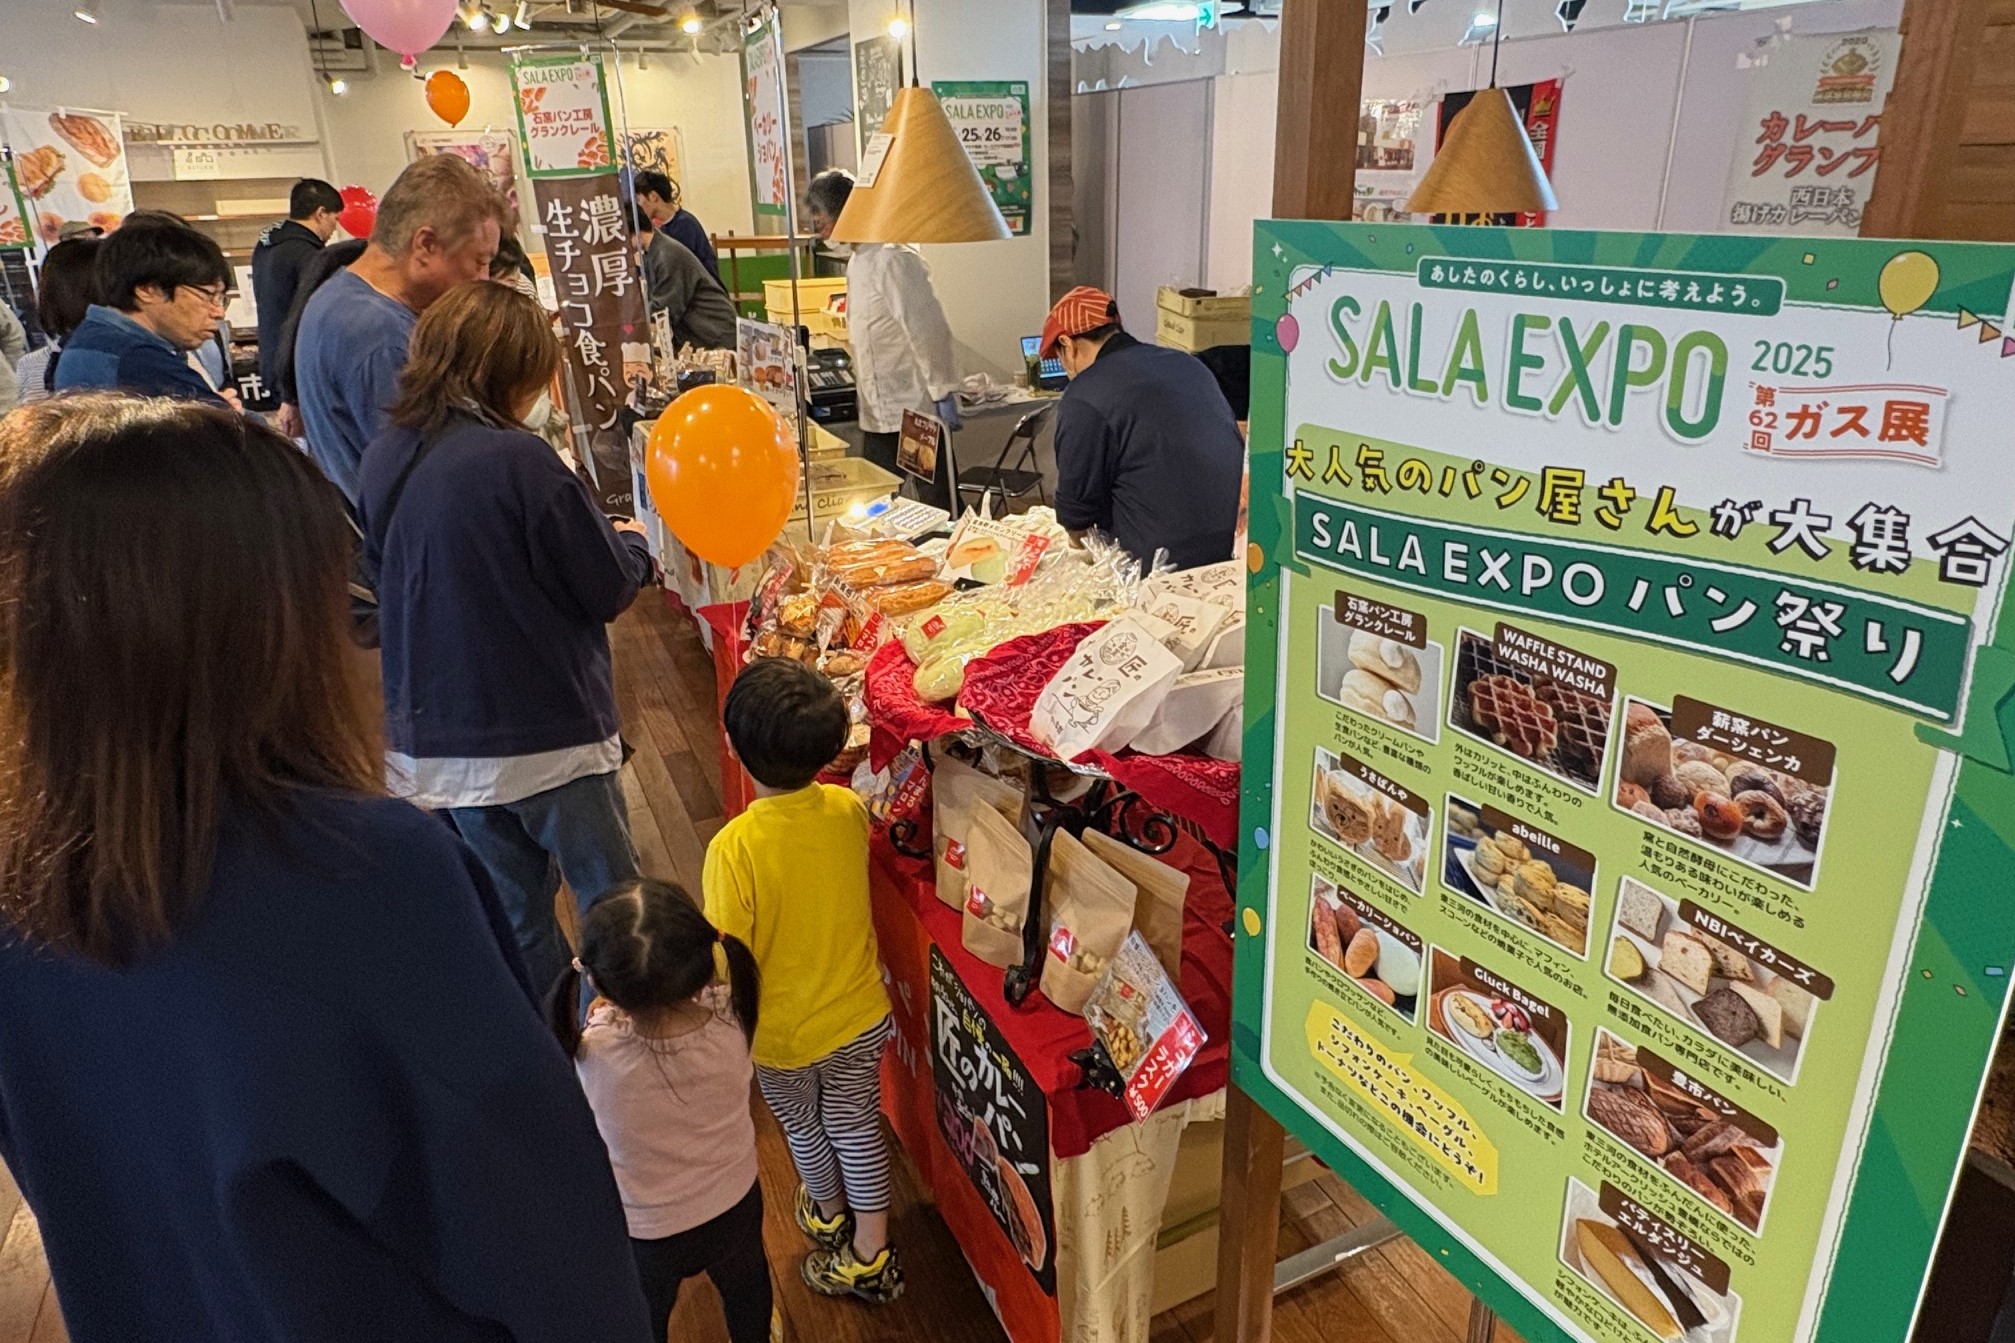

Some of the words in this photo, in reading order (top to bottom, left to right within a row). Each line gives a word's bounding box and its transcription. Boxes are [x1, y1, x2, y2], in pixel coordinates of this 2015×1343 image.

[522, 69, 548, 85] SALA
[550, 67, 573, 82] EXPO
[530, 123, 600, 138] グランクレール
[532, 108, 593, 125] 石窯パン工房
[945, 104, 975, 120] SALA
[976, 103, 1005, 119] EXPO
[1791, 186, 1854, 207] 西日本
[580, 194, 634, 297] 濃厚
[1430, 266, 1761, 307] あしたのくらし、いっしょに考えよう。
[546, 197, 620, 431] 生チョコ食パン
[1328, 296, 1489, 403] SALA
[1511, 311, 1728, 440] EXPO
[1750, 340, 1834, 379] 2025
[1784, 400, 1930, 447] ガス展
[1311, 511, 1428, 577] SALA
[1442, 540, 1606, 607] EXPO
[1626, 573, 1924, 685] パン祭り
[1347, 596, 1413, 628] 石窯パン工房
[1344, 612, 1416, 642] グランクレール
[1498, 643, 1548, 675] WASHA
[1551, 665, 1605, 698] WASHA
[1503, 628, 1555, 661] WAFFLE
[1557, 650, 1606, 680] STAND
[1697, 725, 1802, 773] ダーシェンカ
[1712, 710, 1789, 746] 薪窯パン
[1453, 756, 1549, 807] ワッフルが楽しめます。
[1453, 768, 1558, 826] 香ばしい甘い香りで人気。
[1454, 743, 1582, 809] 外はカリッと、中はふんわりの
[1512, 824, 1561, 854] abeille
[1638, 860, 1740, 915] 人気のベーカリー。
[1640, 844, 1805, 929] 温もりある味わいが楽しめる
[1643, 830, 1800, 912] 窯と自然酵母にこだわった、
[1695, 910, 1816, 984] NBIベイカーズ
[1474, 967, 1511, 996] Gluck
[1512, 988, 1550, 1018] Bagel
[1606, 1003, 1742, 1090] 無添加食パン専門店です。
[1609, 990, 1787, 1102] 毎日食べたい、カラダに美味しい、
[1671, 1069, 1737, 1116] 豊市パン
[1585, 1130, 1757, 1255] 東三河の食材をふんだんに使った、
[1617, 1210, 1705, 1278] エルダンジュ
[1621, 1200, 1706, 1260] パティスリー
